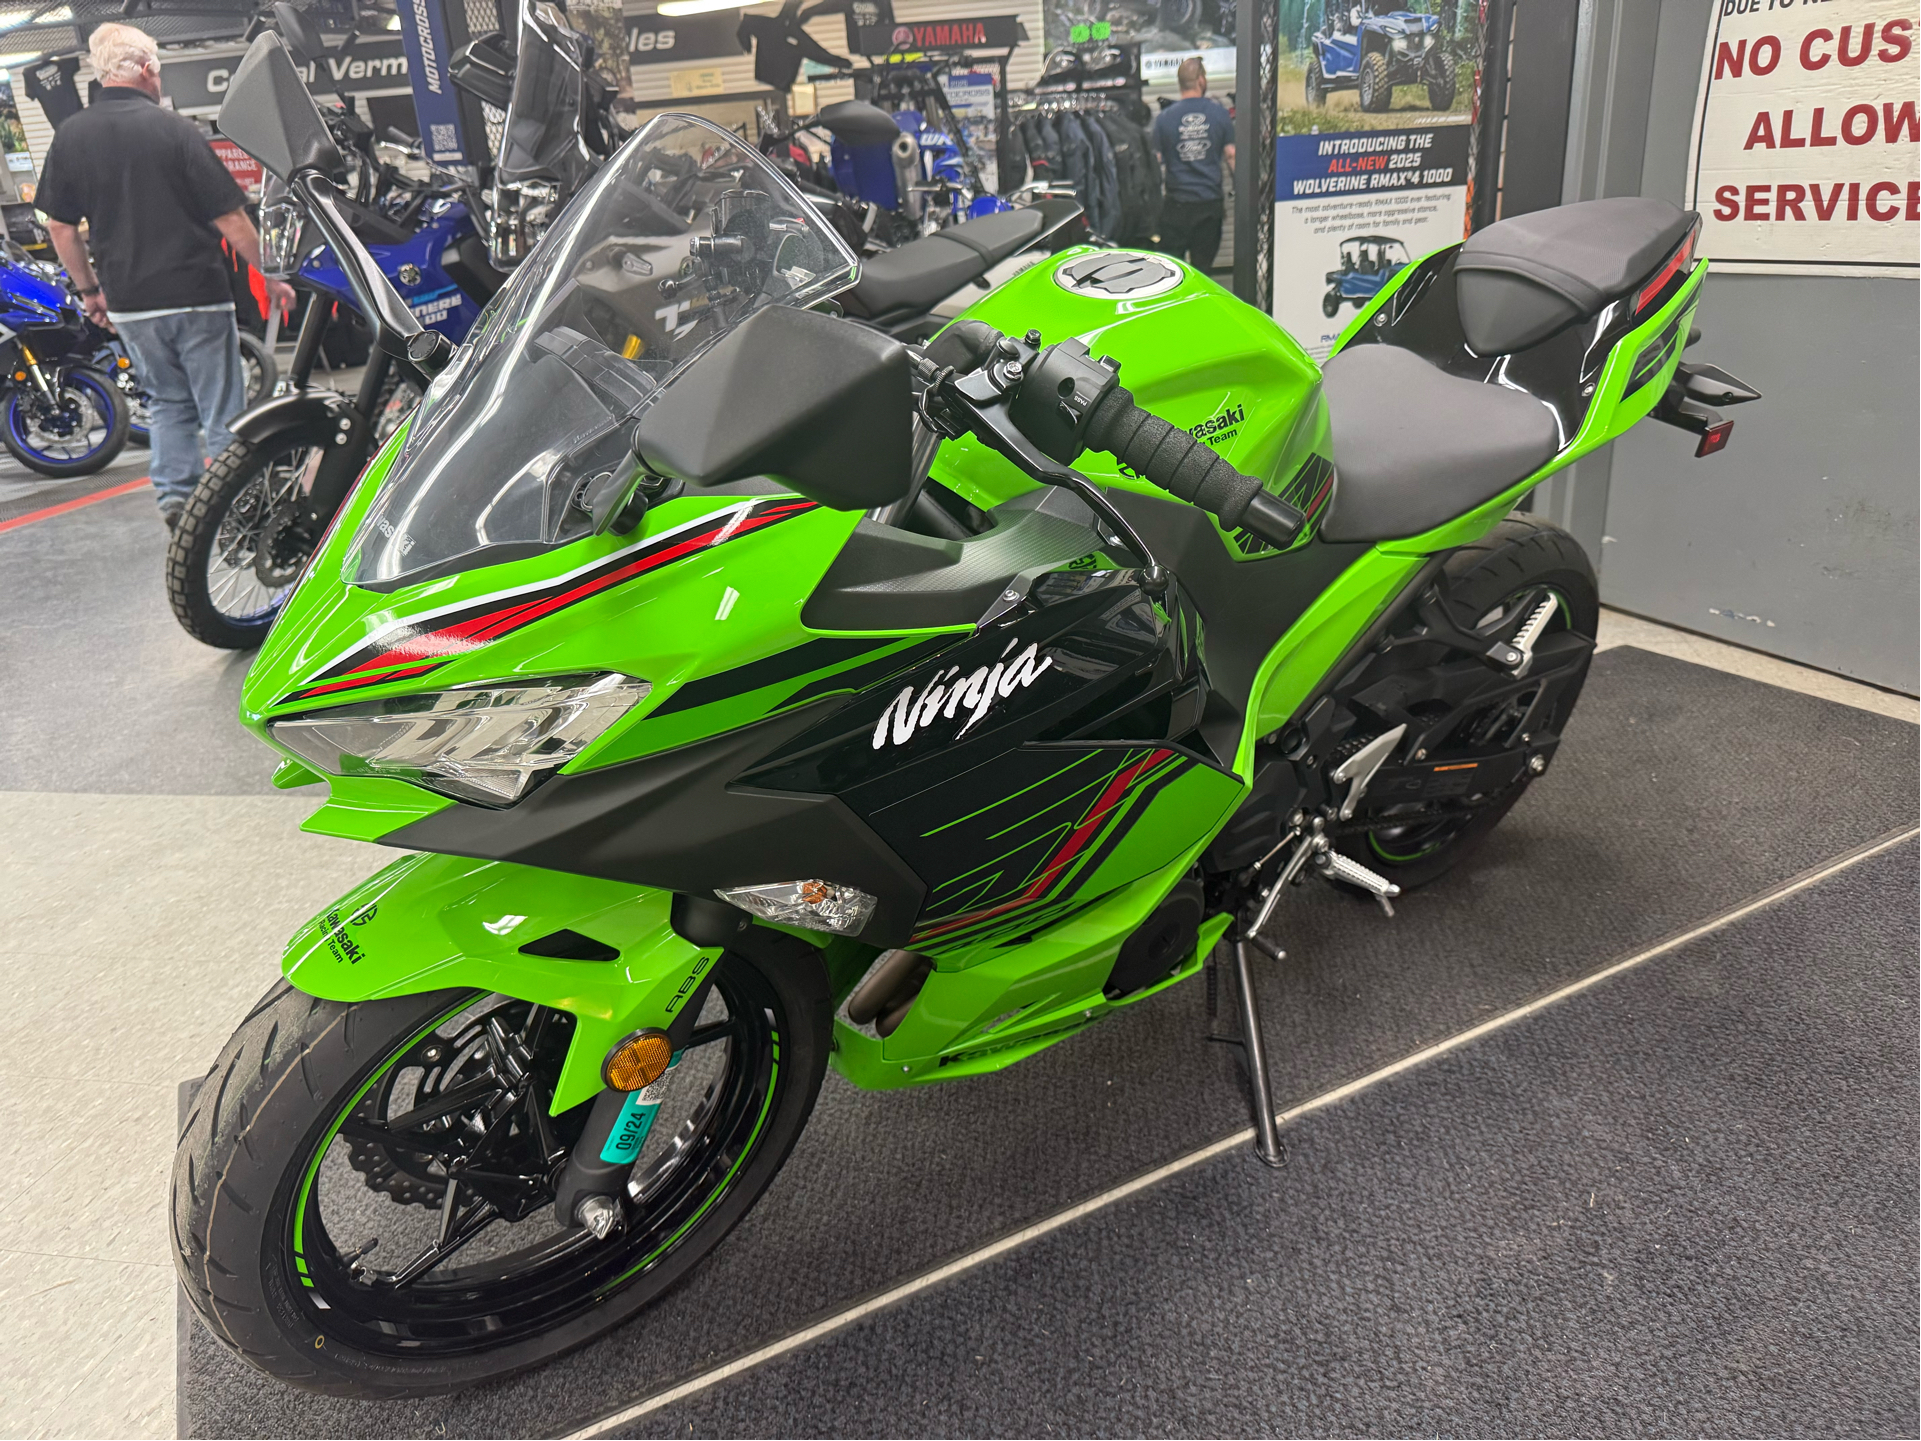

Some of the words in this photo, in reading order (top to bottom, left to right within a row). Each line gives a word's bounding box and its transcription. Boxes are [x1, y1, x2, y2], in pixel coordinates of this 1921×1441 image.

[1723, 0, 1760, 16] DUE
[914, 22, 986, 47] YAMAHA
[1714, 35, 1781, 80] NO
[1800, 18, 1920, 71] CUS
[1743, 101, 1920, 151] ALLOW
[1318, 135, 1407, 156] INTRODUCING
[1409, 133, 1434, 150] THE
[1328, 156, 1388, 173] ALL-NEW
[1388, 152, 1422, 169] 2025
[1293, 172, 1368, 196] WOLVERINE
[1423, 168, 1453, 185] 1000
[1292, 206, 1303, 215] The
[1304, 204, 1320, 213] most
[1410, 195, 1423, 203] ever
[1424, 193, 1452, 203] featuring
[1713, 181, 1920, 222] SERVICE
[1310, 214, 1330, 224] longer
[1366, 210, 1383, 219] more
[1384, 207, 1416, 217] aggressive
[1314, 225, 1326, 234] and
[1327, 223, 1346, 234] plenty
[1347, 221, 1354, 231] of
[1354, 221, 1370, 230] room
[1372, 219, 1381, 229] for
[1382, 217, 1399, 229] family
[1402, 217, 1413, 226] and
[1189, 403, 1245, 439] asaki
[1207, 429, 1238, 446] Team
[872, 637, 1053, 750] Ninja
[327, 938, 344, 964] Team
[665, 956, 710, 1013] ABS
[615, 1112, 646, 1151] 09/24
